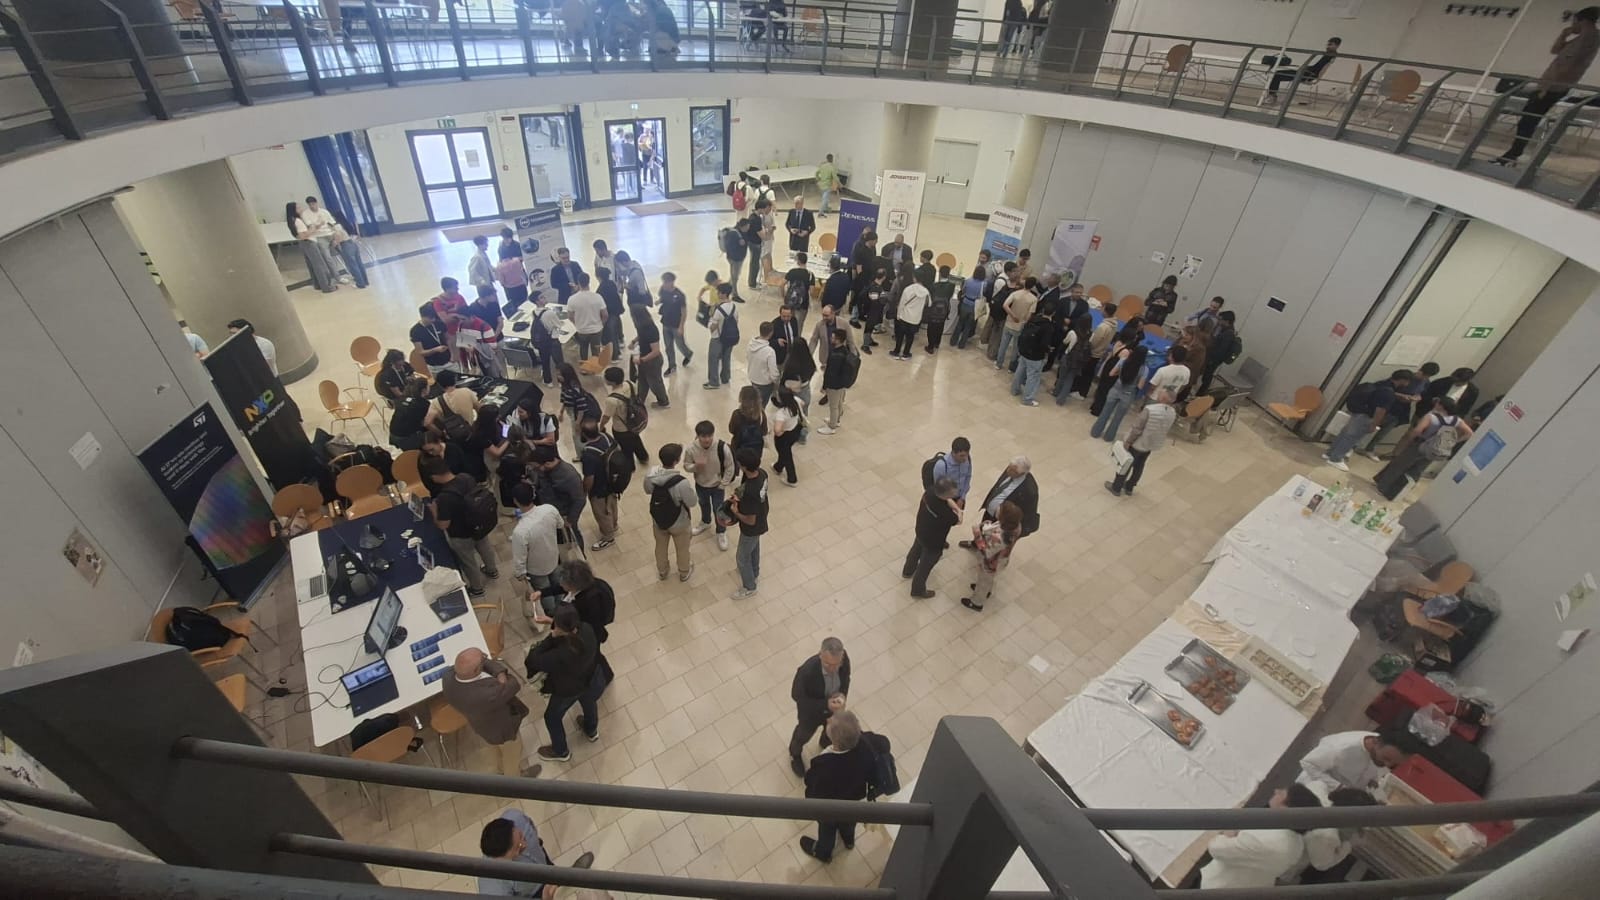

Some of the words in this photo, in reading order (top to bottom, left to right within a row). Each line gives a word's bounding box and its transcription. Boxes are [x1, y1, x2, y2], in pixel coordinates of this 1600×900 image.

[889, 174, 920, 182] ADVANTEST
[994, 209, 1024, 224] ADVANTEST
[244, 389, 274, 422] NXP
[193, 411, 206, 427] ST
